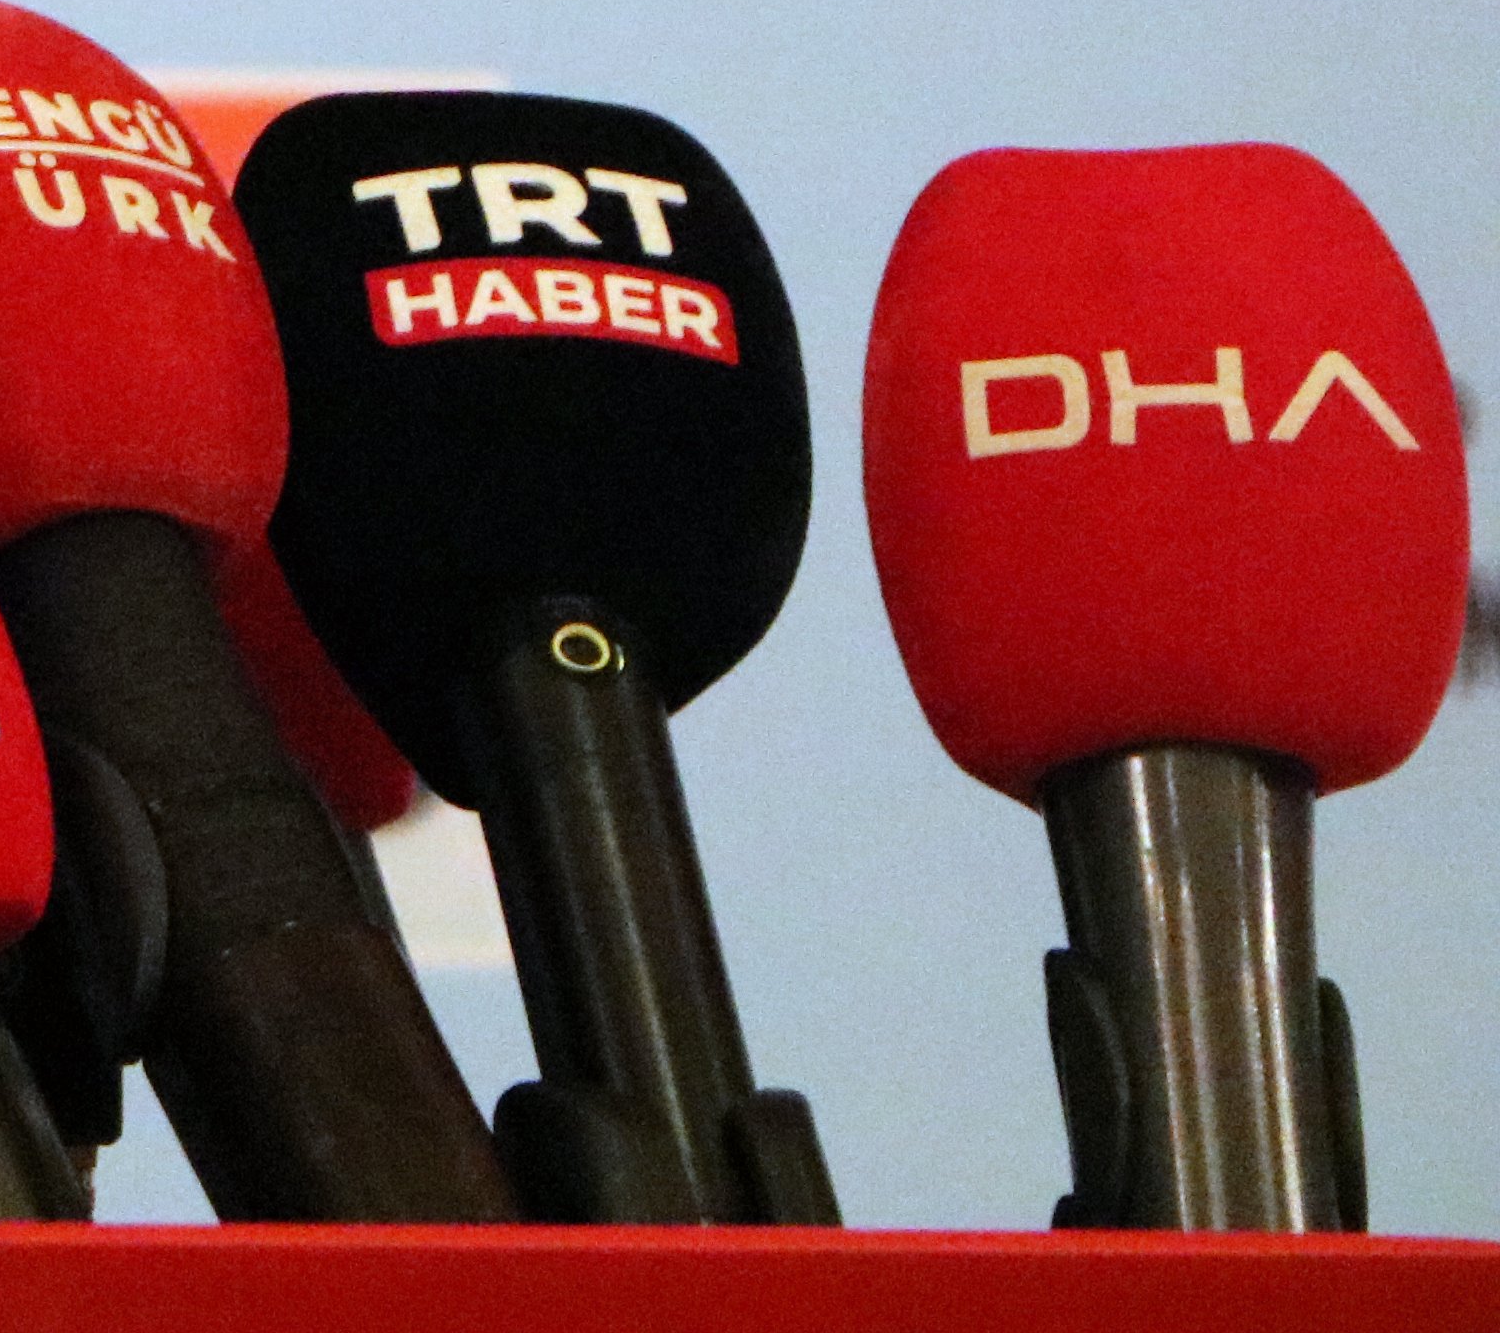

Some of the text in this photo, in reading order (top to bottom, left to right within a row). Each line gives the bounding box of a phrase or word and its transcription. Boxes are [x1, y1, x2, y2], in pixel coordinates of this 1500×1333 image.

[351, 162, 689, 259] TRT
[385, 268, 722, 350] HABER
[959, 345, 1421, 460] DHA
